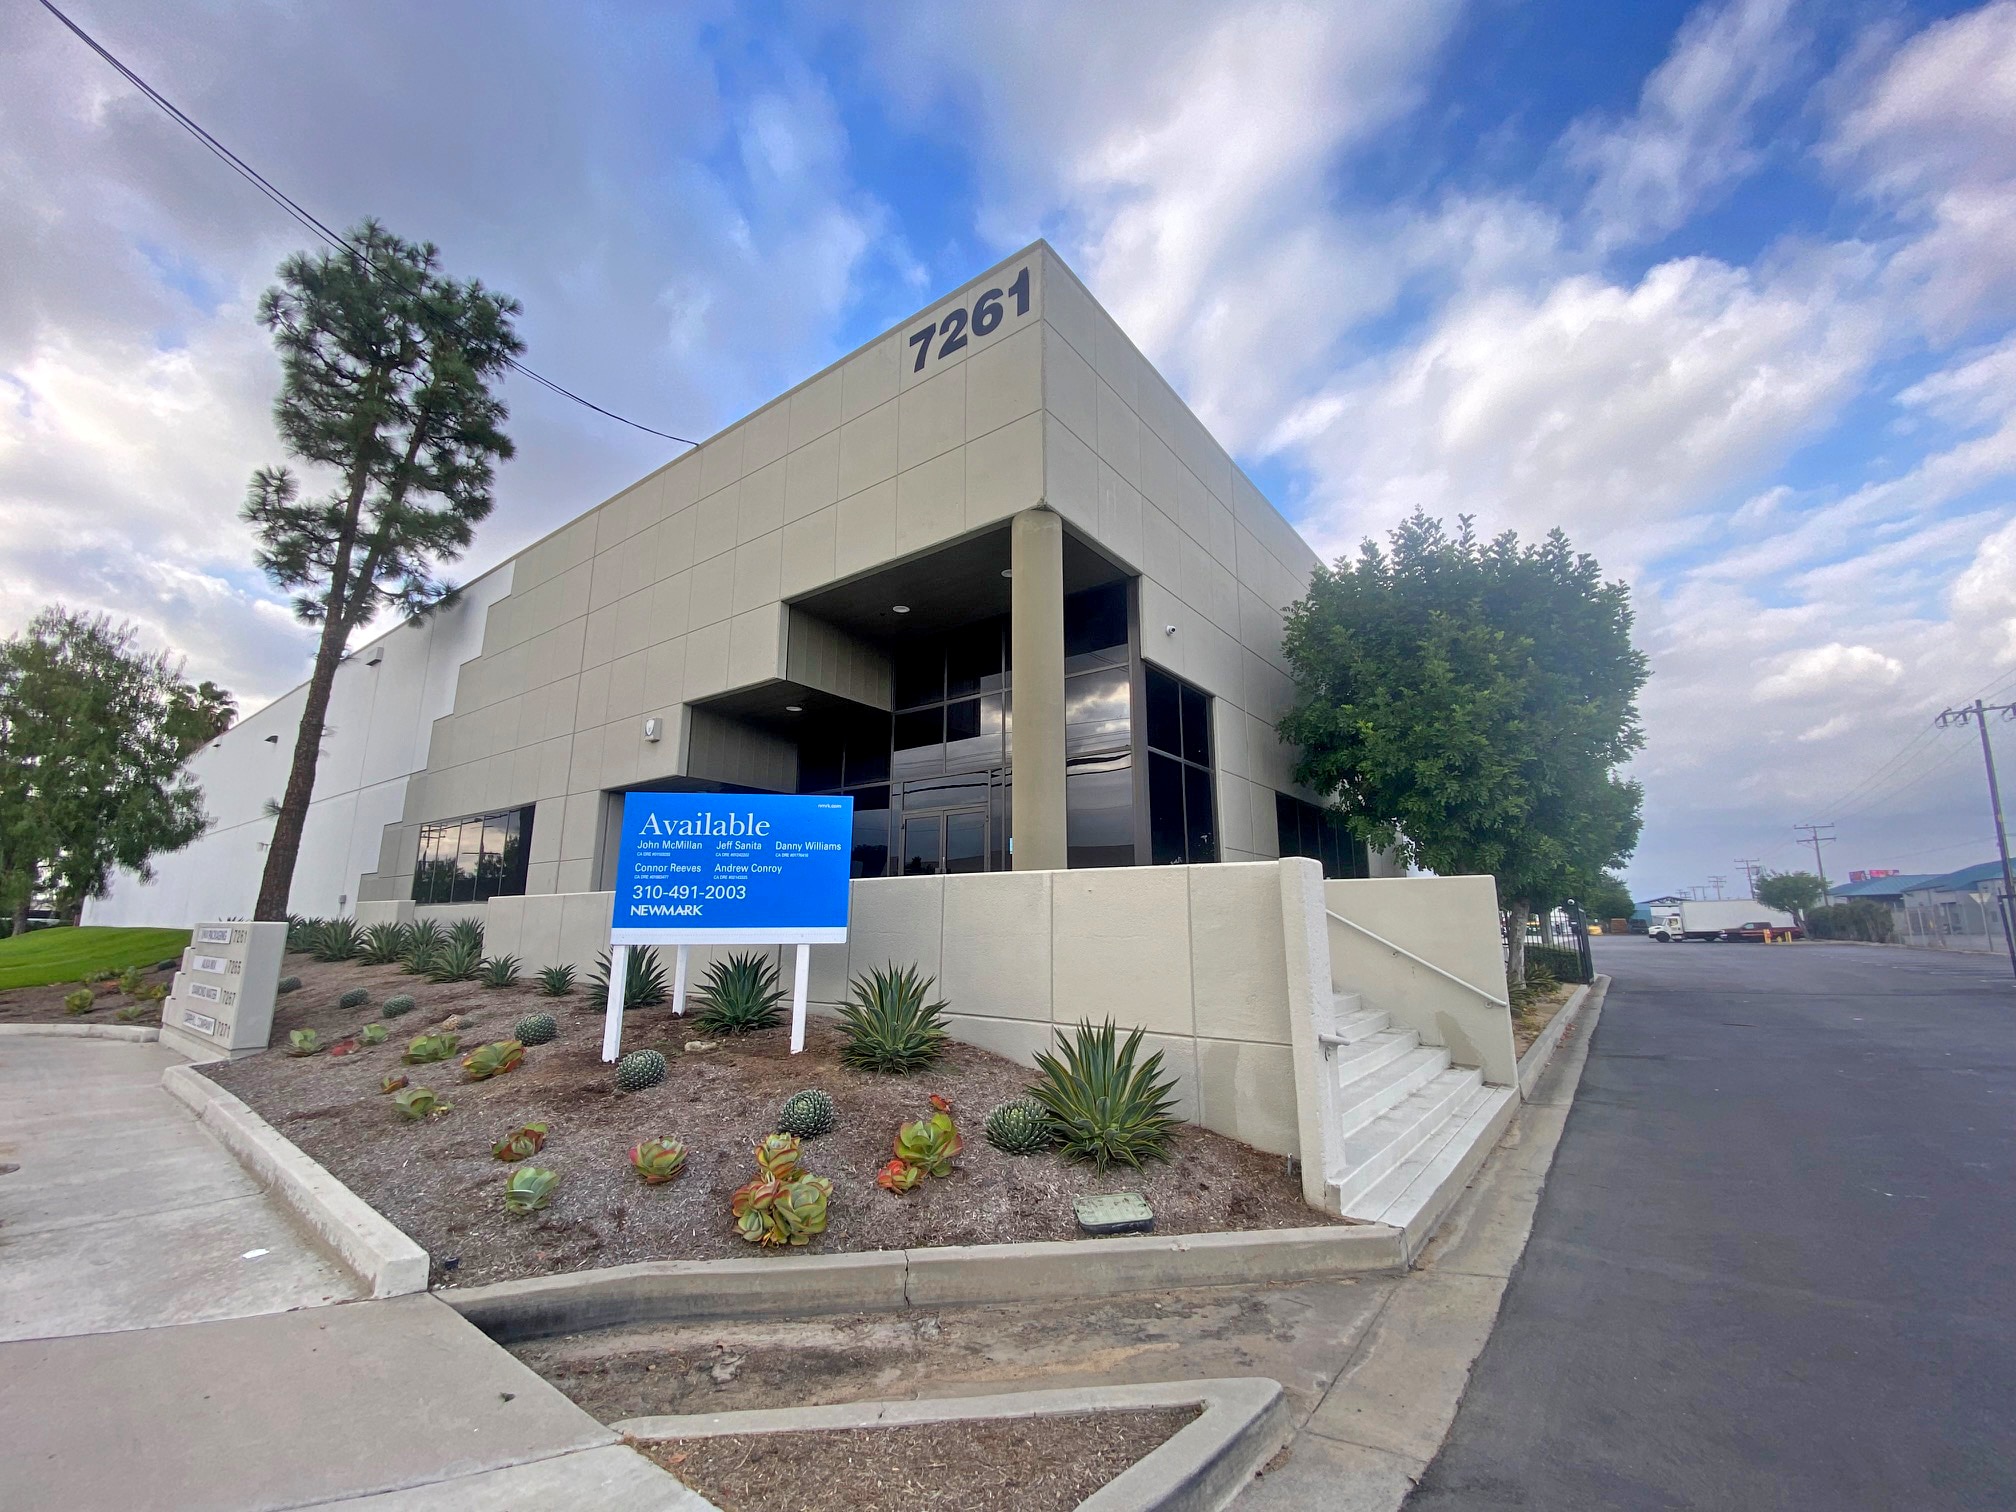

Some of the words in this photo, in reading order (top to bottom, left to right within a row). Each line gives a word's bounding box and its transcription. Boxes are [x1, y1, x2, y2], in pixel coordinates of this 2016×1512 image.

[909, 266, 1030, 374] 7261
[639, 812, 771, 837] Available
[637, 840, 660, 850] John
[662, 840, 703, 850] McMillan
[716, 840, 733, 850] Jeff
[734, 841, 762, 850] Sanita
[775, 841, 803, 852] Danny
[805, 841, 842, 851] Williams
[634, 863, 668, 873] Connor
[670, 863, 702, 873] Reeves
[714, 863, 749, 873] Andrew
[751, 863, 782, 875] Conroy
[632, 885, 747, 900] 310-491-2003
[630, 904, 704, 916] NEWMARK
[233, 930, 248, 943] 7261
[222, 990, 236, 1005] 7267
[216, 1021, 231, 1038] 7271
